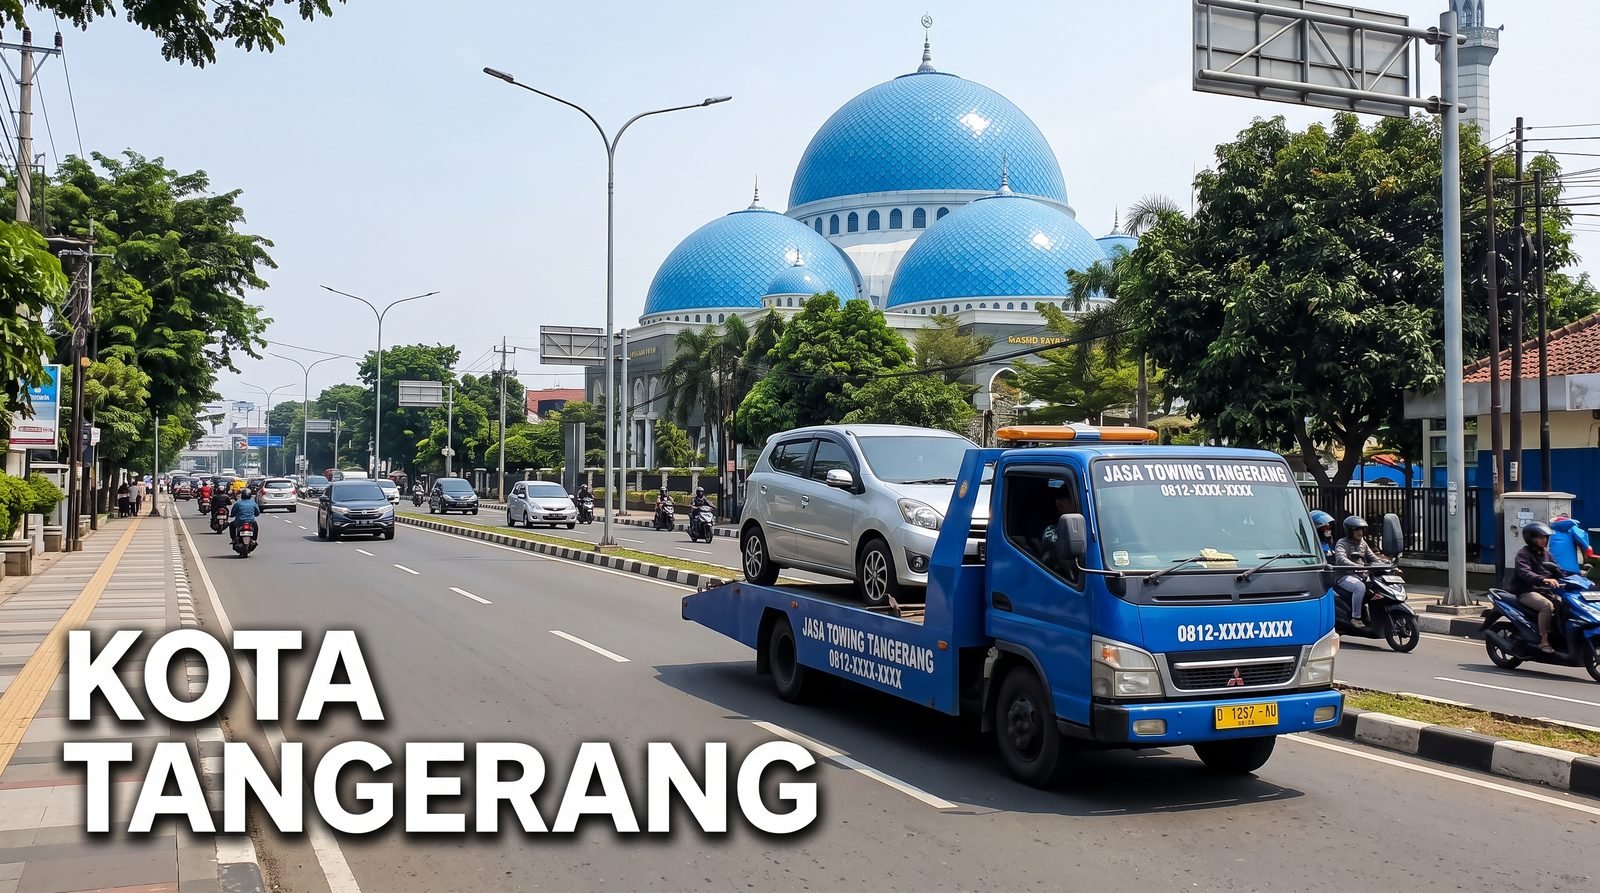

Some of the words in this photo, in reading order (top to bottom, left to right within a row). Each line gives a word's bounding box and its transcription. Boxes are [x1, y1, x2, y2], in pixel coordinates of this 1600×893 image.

[1103, 464, 1144, 482] JASA
[1144, 464, 1205, 481] TOWING
[1207, 465, 1288, 483] TANGERANG
[1160, 484, 1254, 497] 0812-XXXX-XXXX
[1177, 620, 1293, 642] 0812-XXXX-XXXX
[802, 616, 825, 642] JASA
[826, 623, 865, 653] TOWING
[867, 633, 933, 673] TANGERANG
[829, 649, 902, 689] 0812-XXXX-XXXX
[1217, 708, 1223, 721] D
